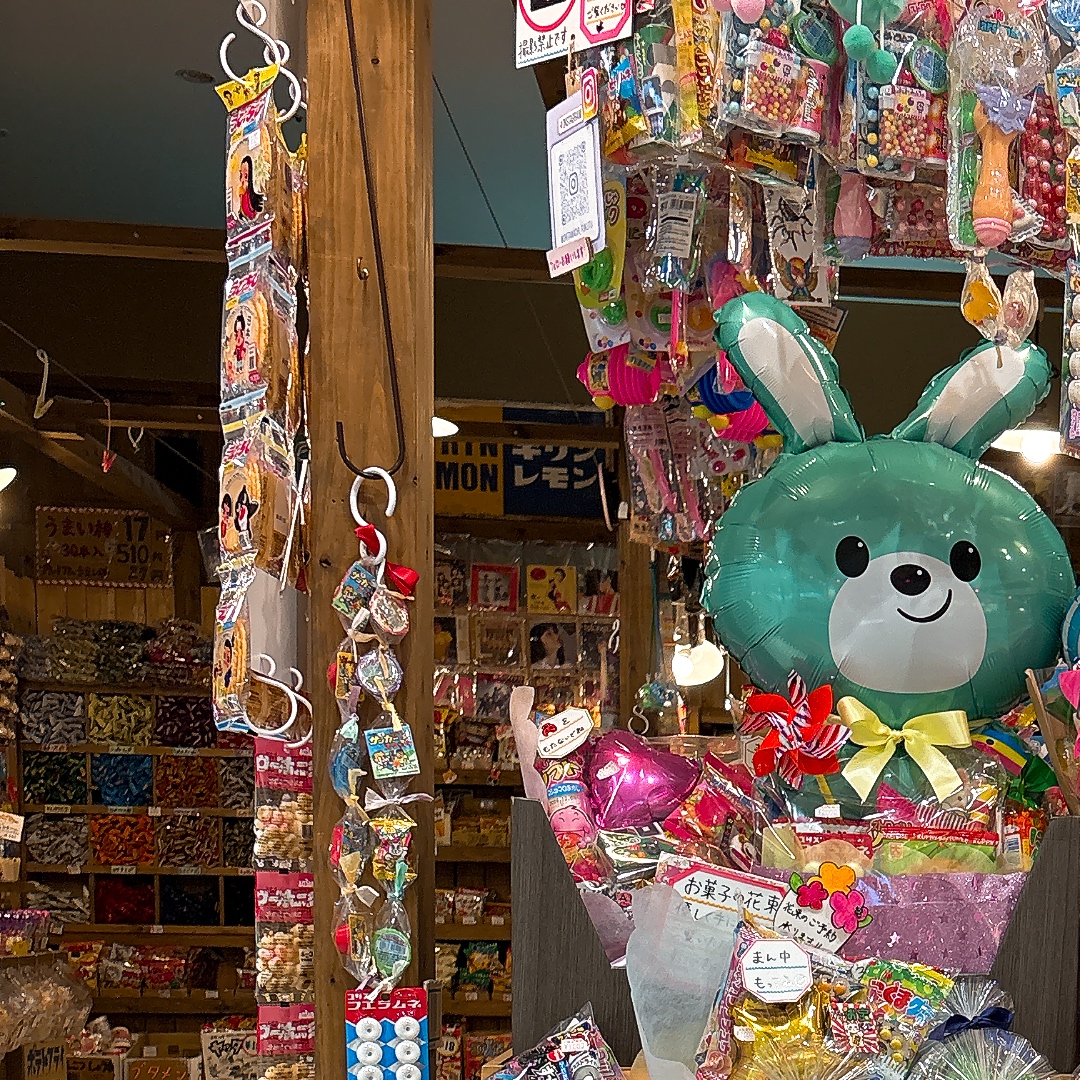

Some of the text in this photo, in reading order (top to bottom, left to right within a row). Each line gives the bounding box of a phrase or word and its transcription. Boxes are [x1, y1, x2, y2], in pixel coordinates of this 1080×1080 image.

[514, 464, 597, 490] レモン
[123, 515, 149, 542] 17
[116, 543, 149, 564] 510
[685, 876, 782, 913] お菓子の花束
[752, 950, 792, 965] まん中
[347, 999, 422, 1011] フエラムネ
[131, 1062, 188, 1080] ブタメン
